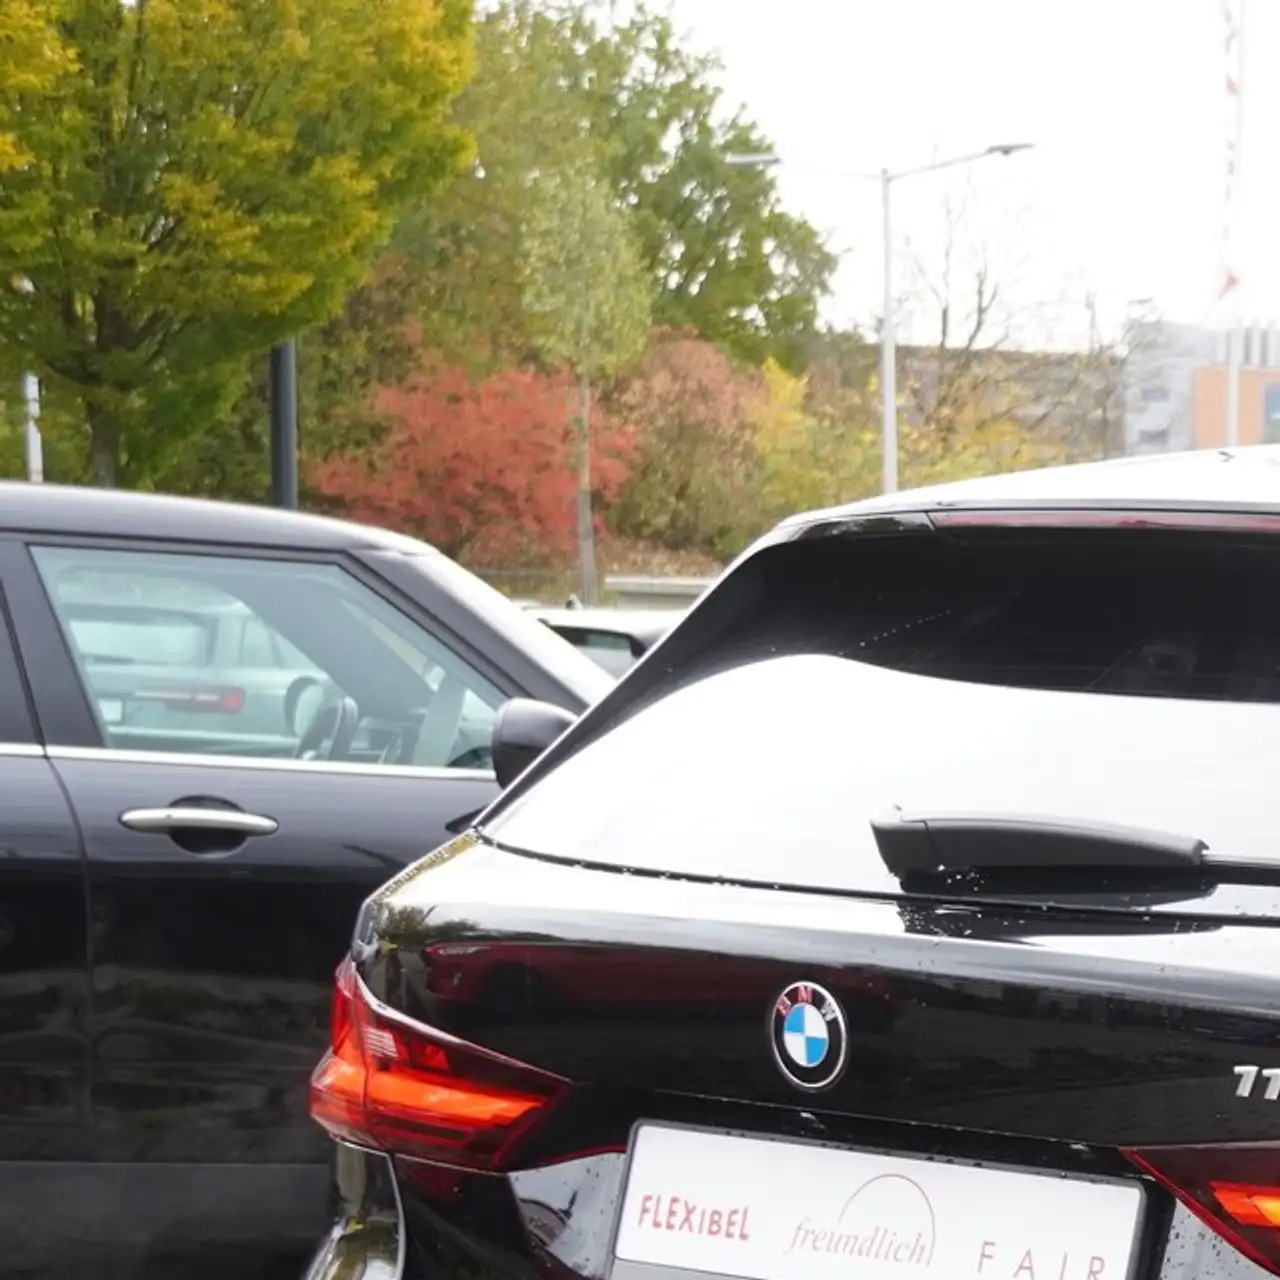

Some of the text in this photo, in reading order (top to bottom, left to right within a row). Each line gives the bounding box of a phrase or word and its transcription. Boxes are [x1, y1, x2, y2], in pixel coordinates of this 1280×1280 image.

[776, 985, 839, 1022] BMW
[638, 1194, 750, 1242] FLEXIBEL
[783, 1216, 927, 1266] freundlich
